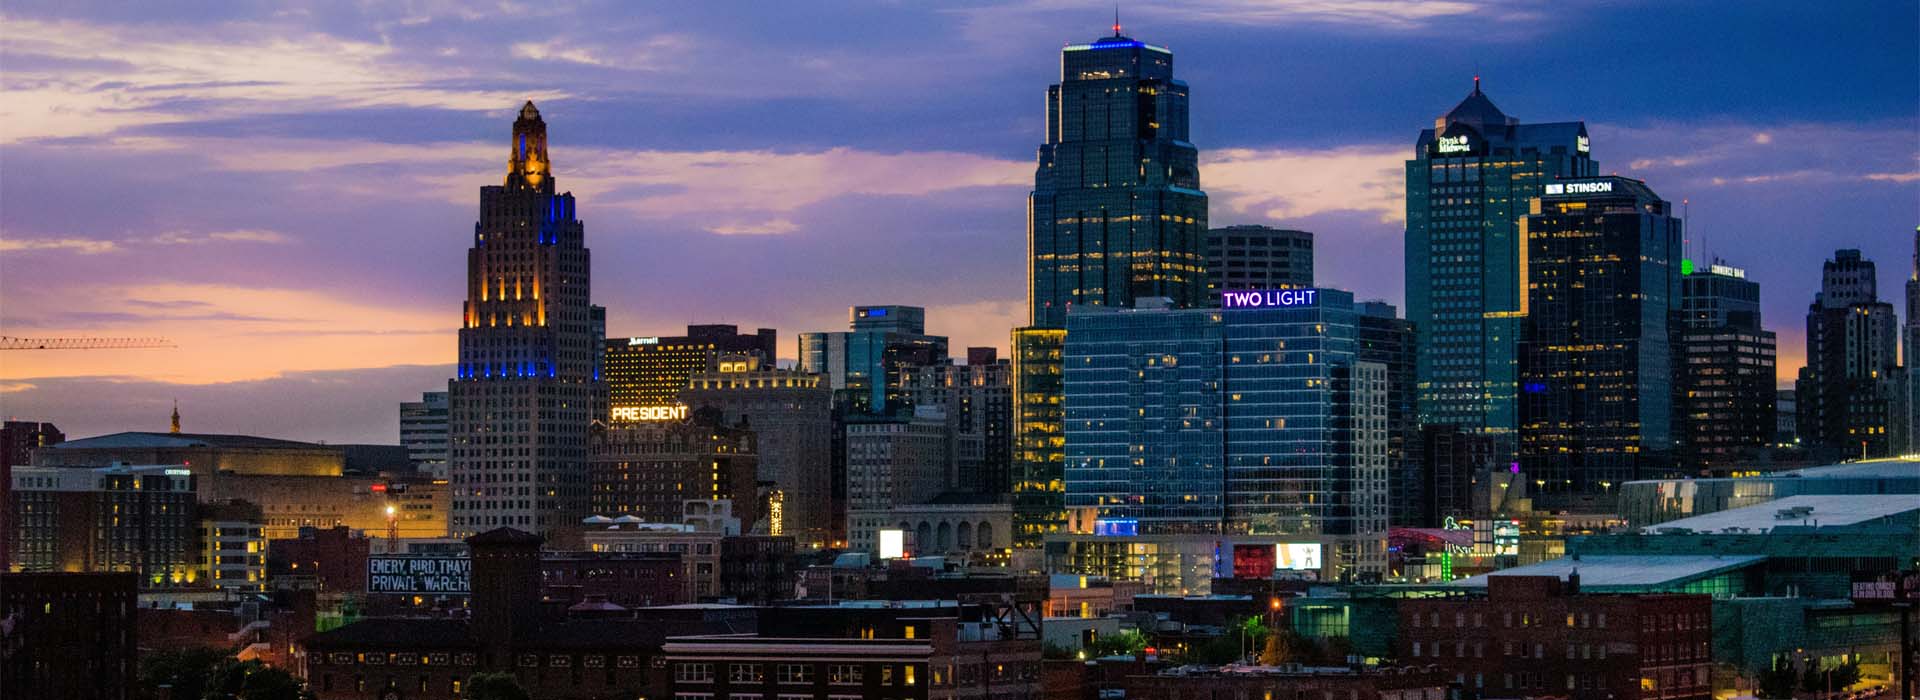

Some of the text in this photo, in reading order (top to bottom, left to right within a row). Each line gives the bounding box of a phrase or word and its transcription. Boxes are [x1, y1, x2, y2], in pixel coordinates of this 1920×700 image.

[1439, 136, 1459, 145] Bank
[1439, 144, 1470, 153] Midwest
[1566, 182, 1612, 193] STINSON
[1223, 290, 1316, 307] TWO LIGHT
[628, 336, 659, 346] Marriott
[612, 405, 688, 421] PRESIDENT
